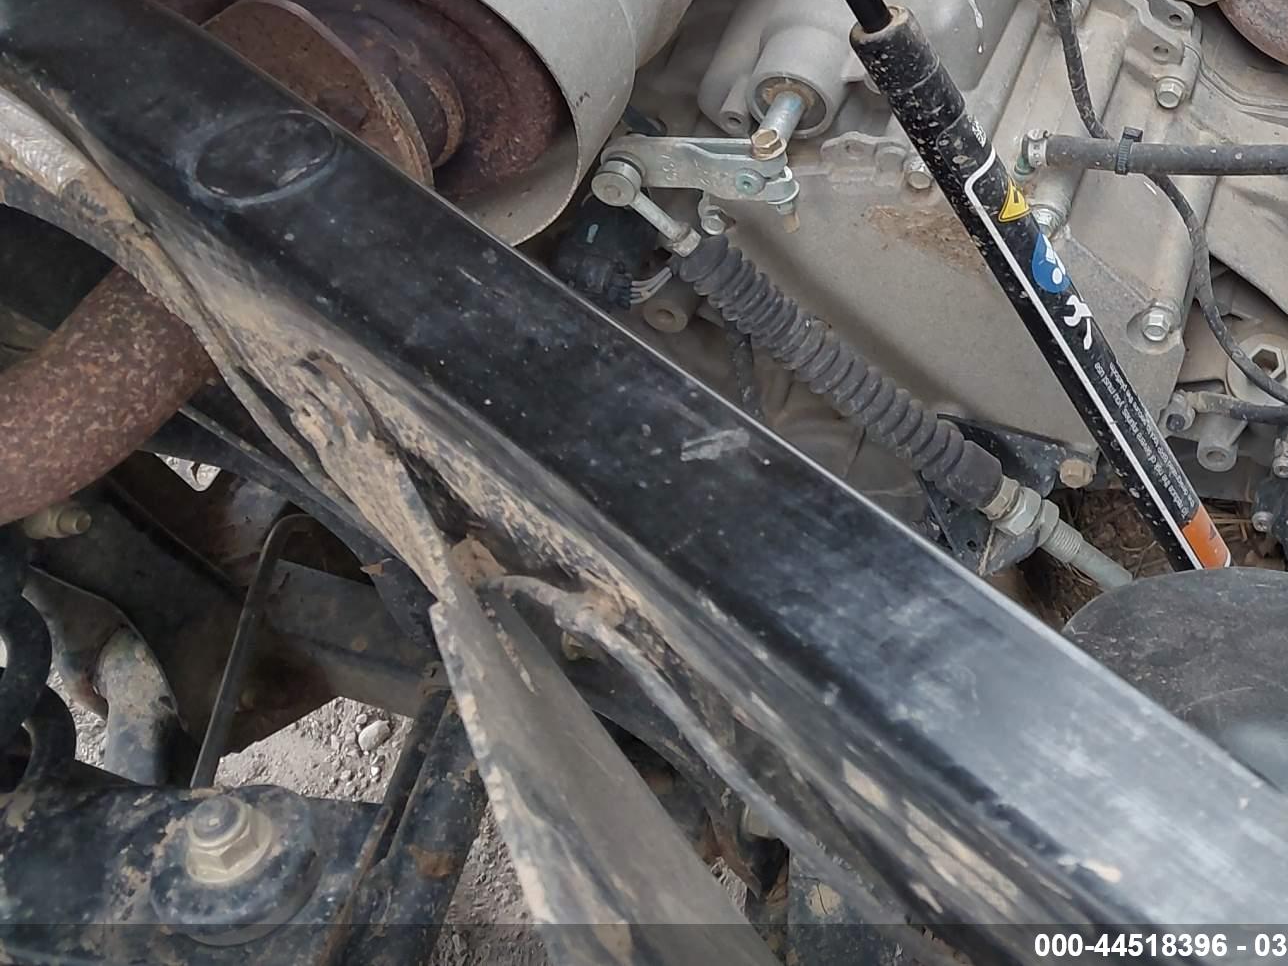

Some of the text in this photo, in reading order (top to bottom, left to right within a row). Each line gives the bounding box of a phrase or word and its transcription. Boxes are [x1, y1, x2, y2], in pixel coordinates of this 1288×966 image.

[1095, 362, 1105, 377] use
[1102, 377, 1116, 396] must
[1114, 394, 1124, 407] you
[1137, 432, 1153, 456] severe
[1154, 463, 1163, 476] risk
[1162, 475, 1170, 488] the
[1168, 487, 1186, 509] reduce
